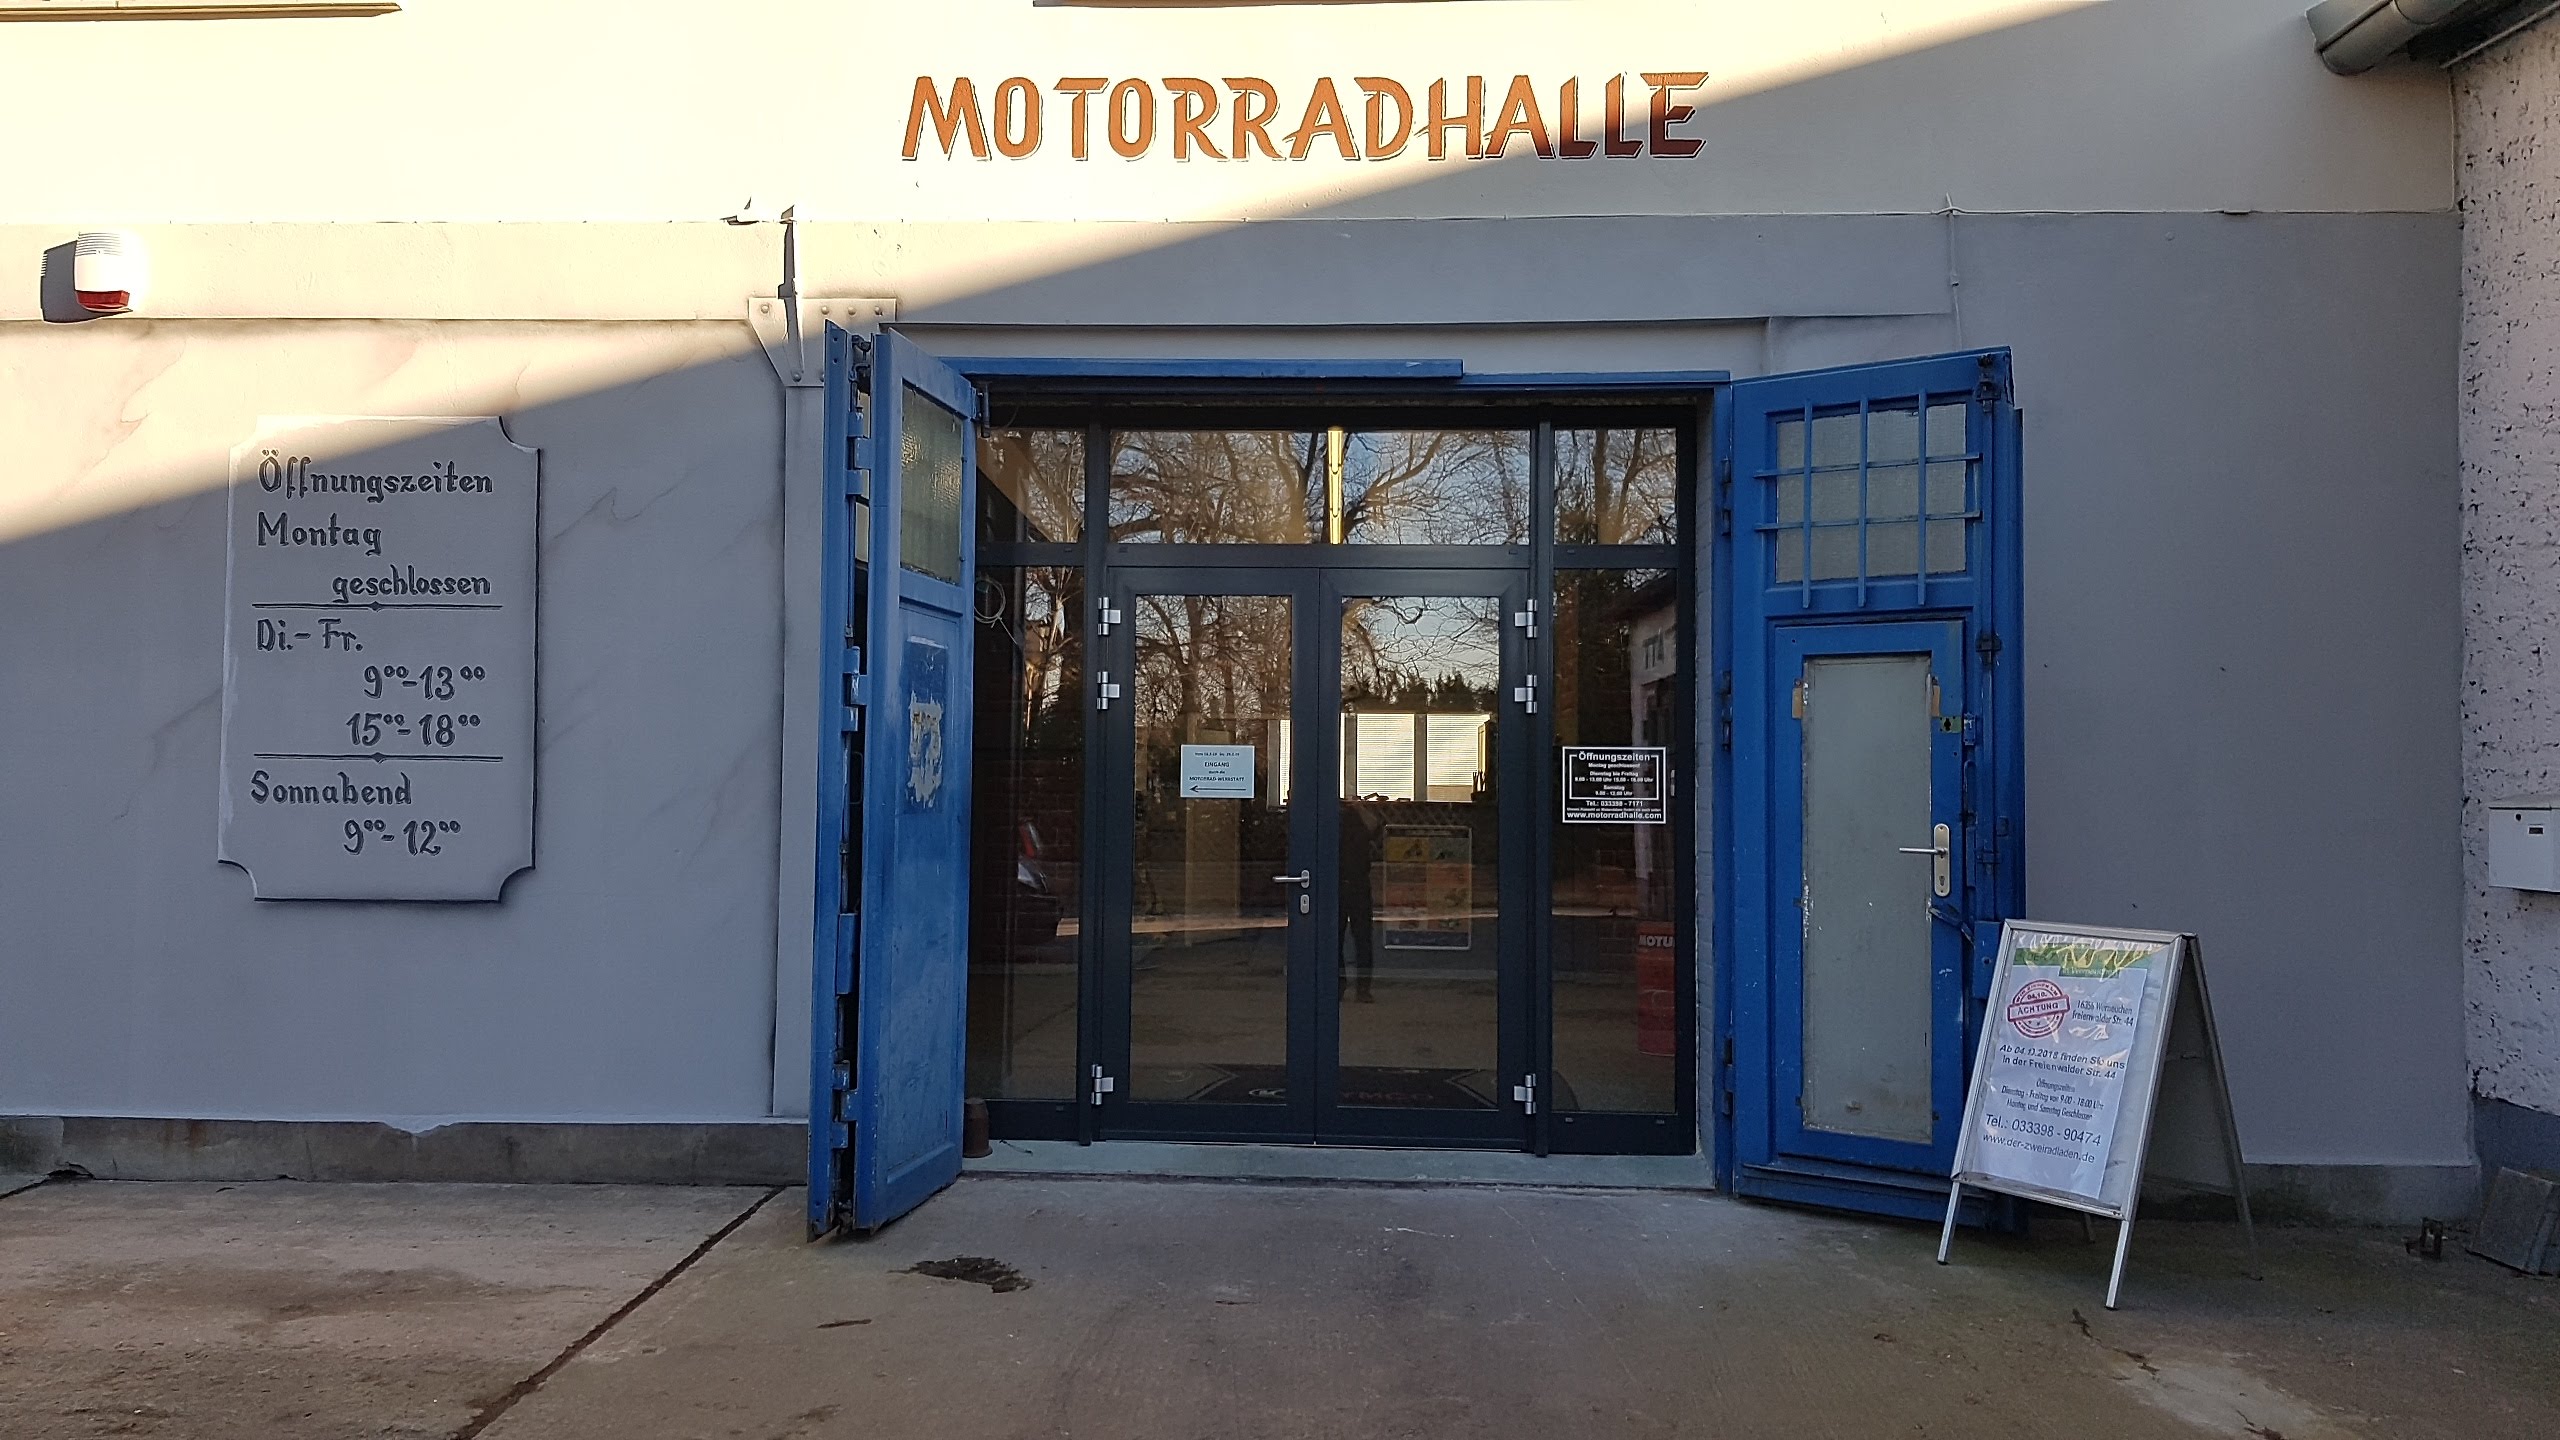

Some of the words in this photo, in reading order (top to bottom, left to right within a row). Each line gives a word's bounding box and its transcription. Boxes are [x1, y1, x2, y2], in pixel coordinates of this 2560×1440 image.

[901, 72, 1709, 162] MOTORRADHALLE
[258, 449, 493, 502] Öffnungszeiten
[257, 512, 382, 556] Montag
[332, 565, 491, 602] geschlossen
[1578, 750, 1650, 762] Öffnungszeiten
[251, 770, 412, 805] Sonnabend
[2017, 1001, 2059, 1015] ACHTUNG
[2000, 1044, 2012, 1052] Ab
[2060, 1052, 2087, 1064] finden
[2107, 1060, 2125, 1069] uns
[2012, 1056, 2026, 1066] der
[2029, 1060, 2084, 1075] Freienwalder
[2104, 1071, 2116, 1079] 44
[1986, 1114, 2008, 1129] Tel.:
[2011, 1119, 2054, 1137] 033398
[2063, 1128, 2101, 1146] 90474
[1982, 1134, 2095, 1163] www.der-zweiradladen.de
